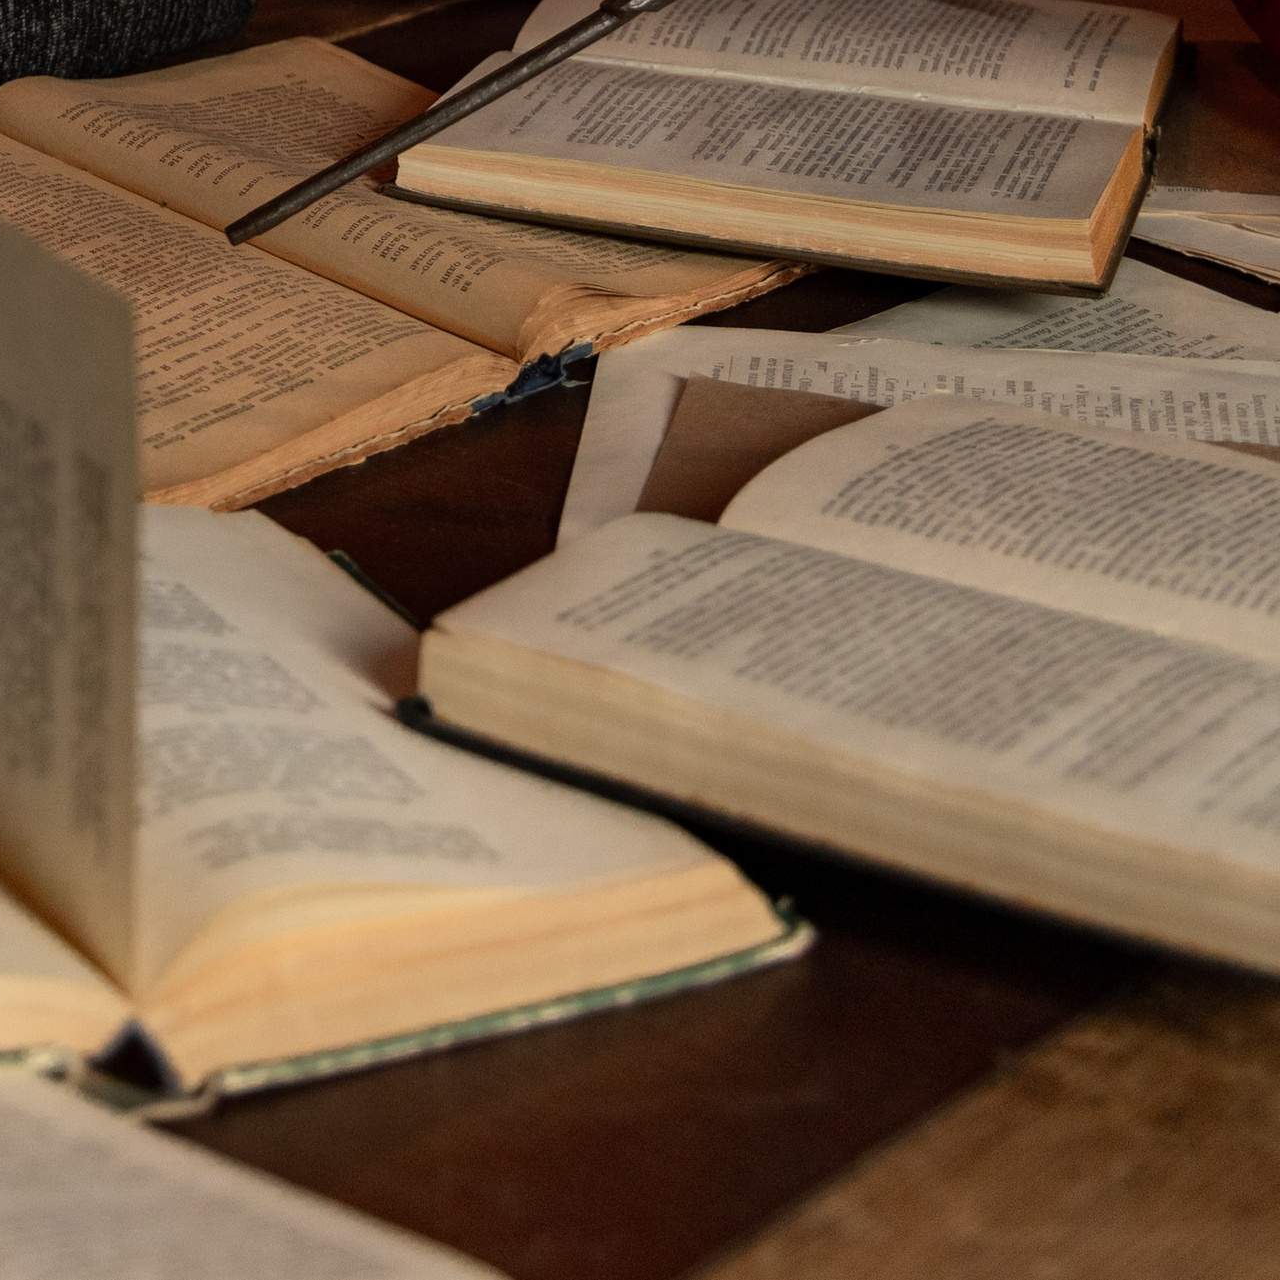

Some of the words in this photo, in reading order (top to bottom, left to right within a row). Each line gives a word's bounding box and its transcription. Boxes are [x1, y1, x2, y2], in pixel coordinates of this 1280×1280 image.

[166, 154, 183, 167] Не
[193, 160, 212, 178] уже
[340, 214, 370, 241] вышел
[378, 232, 406, 259] балки
[389, 243, 409, 263] Вот
[439, 260, 461, 284] один
[459, 280, 472, 292] за
[211, 294, 225, 302] И
[1161, 329, 1177, 338] И
